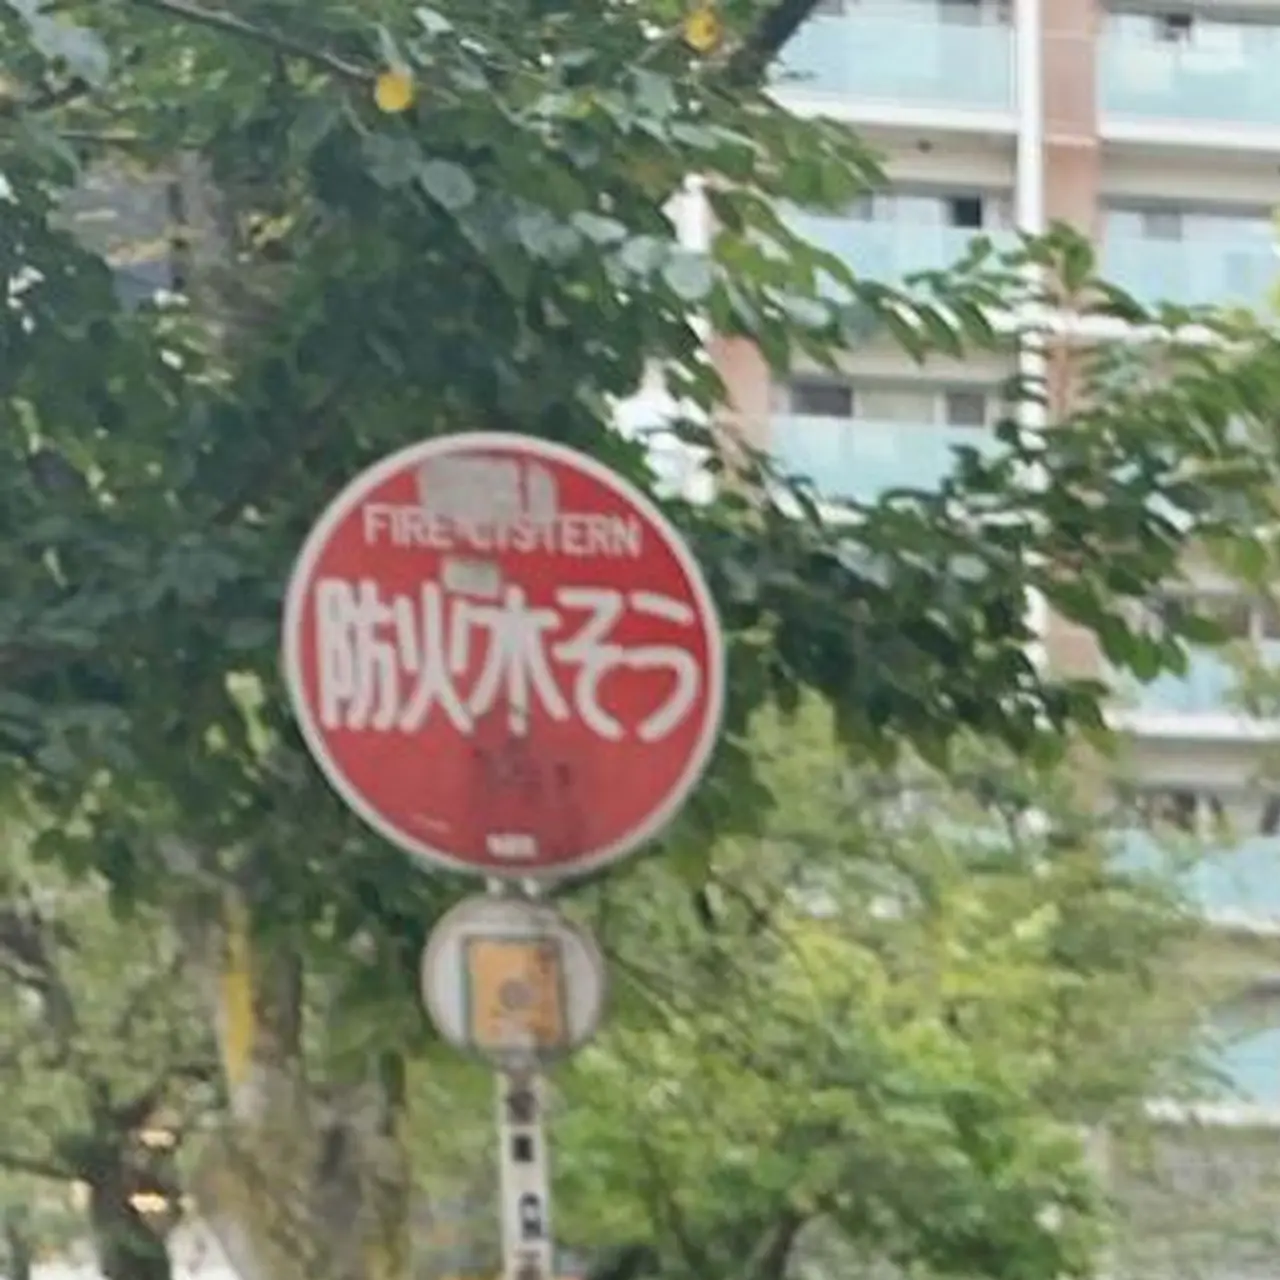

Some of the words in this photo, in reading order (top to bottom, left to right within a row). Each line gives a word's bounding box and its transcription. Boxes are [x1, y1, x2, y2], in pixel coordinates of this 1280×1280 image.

[363, 503, 452, 548] FIRE
[466, 511, 643, 558] CISTERN
[315, 579, 699, 742] 防火水そう
